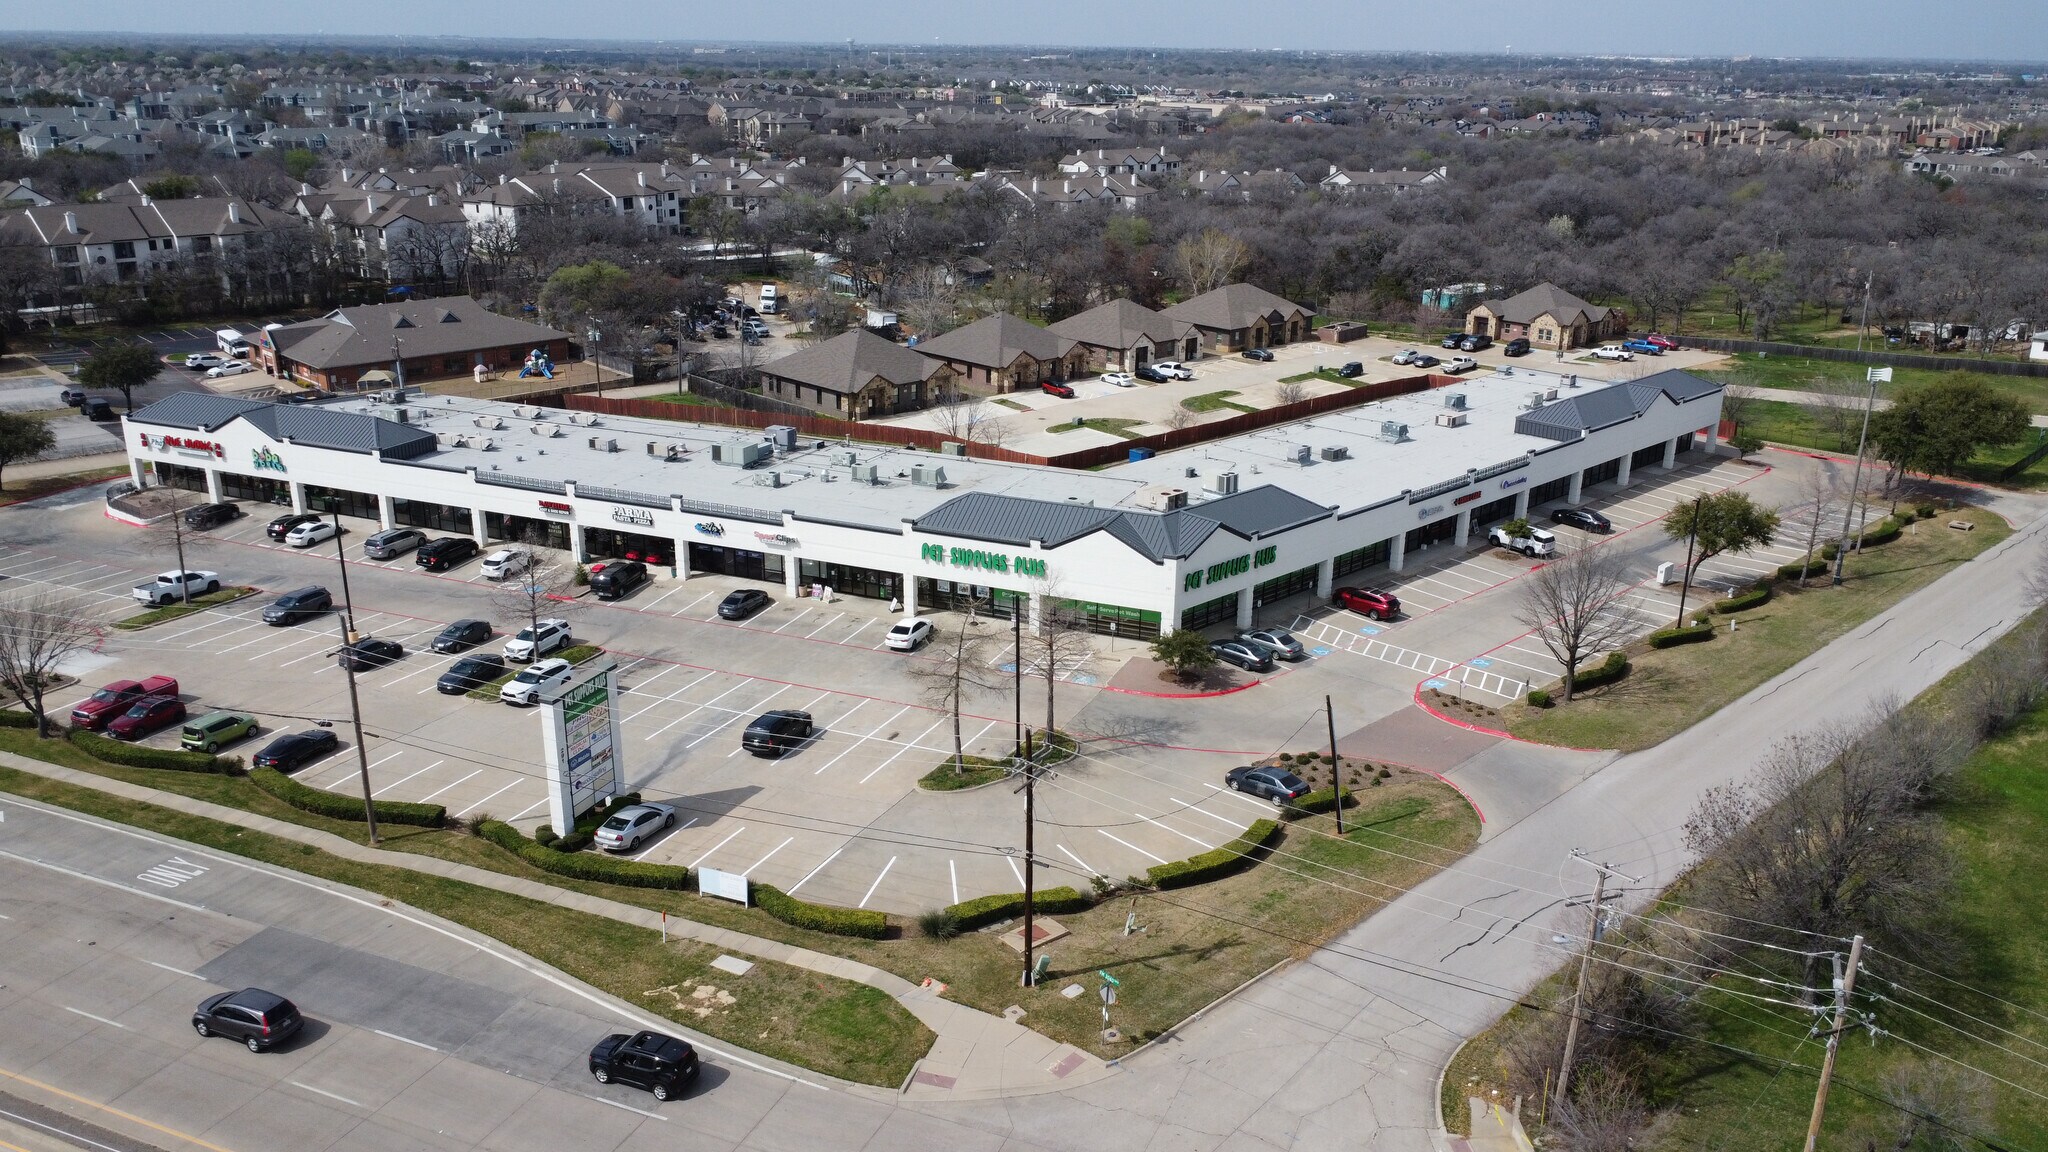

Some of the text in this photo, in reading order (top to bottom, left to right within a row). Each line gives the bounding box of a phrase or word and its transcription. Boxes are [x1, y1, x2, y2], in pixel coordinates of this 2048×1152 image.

[612, 506, 652, 519] PARMA
[921, 542, 1046, 577] PET SUPPLIES PLUS
[1185, 545, 1277, 592] PET SUPPLIES PLUS
[137, 856, 210, 888] ONLY
